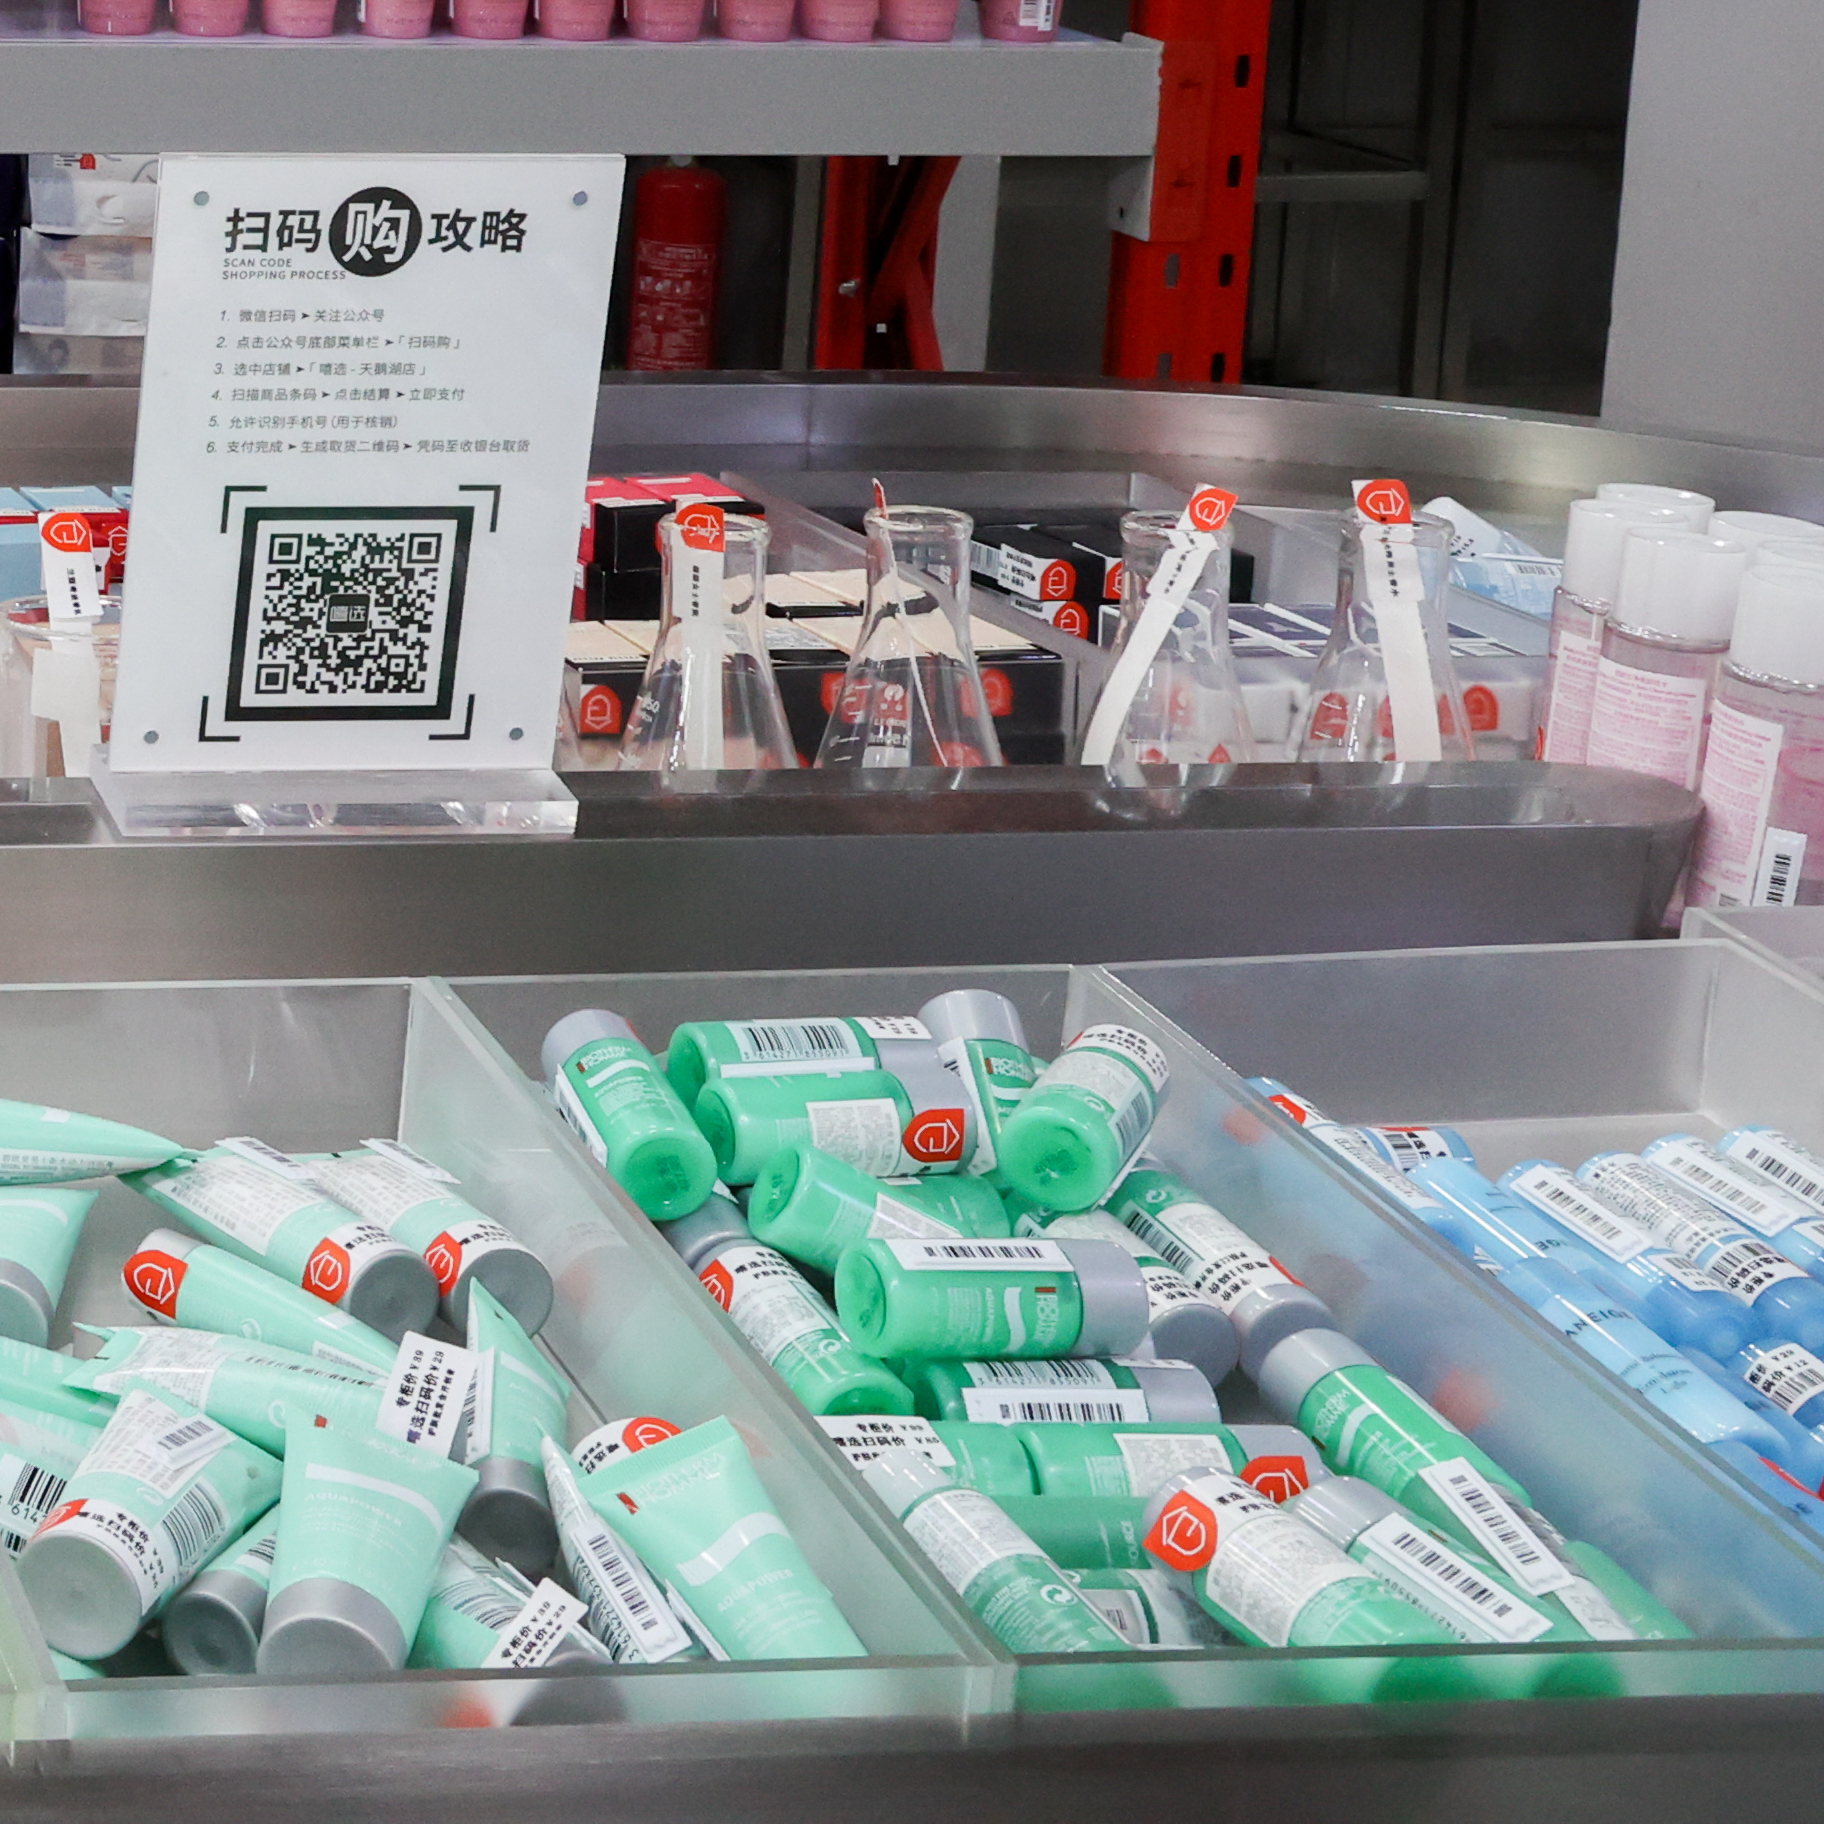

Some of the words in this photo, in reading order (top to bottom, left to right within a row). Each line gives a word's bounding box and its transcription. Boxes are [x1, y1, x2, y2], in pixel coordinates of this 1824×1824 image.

[222, 257, 255, 268] SCAN
[259, 257, 292, 268] CODE
[222, 269, 287, 281] SHOPPING
[290, 269, 347, 281] PROCESS
[239, 309, 296, 323] 微信扫码
[314, 309, 385, 323] 关注公众号
[236, 336, 379, 350] 点击公众号底部菜单栏
[233, 362, 291, 376] 选中店铺
[232, 388, 317, 402] 扫描商品条码
[334, 387, 391, 402] 点击结算
[408, 387, 465, 402] 立即支付
[227, 440, 283, 454] 支付完成
[300, 440, 399, 454] 生成取货二维码
[416, 440, 530, 455] 凭码至收银台取货
